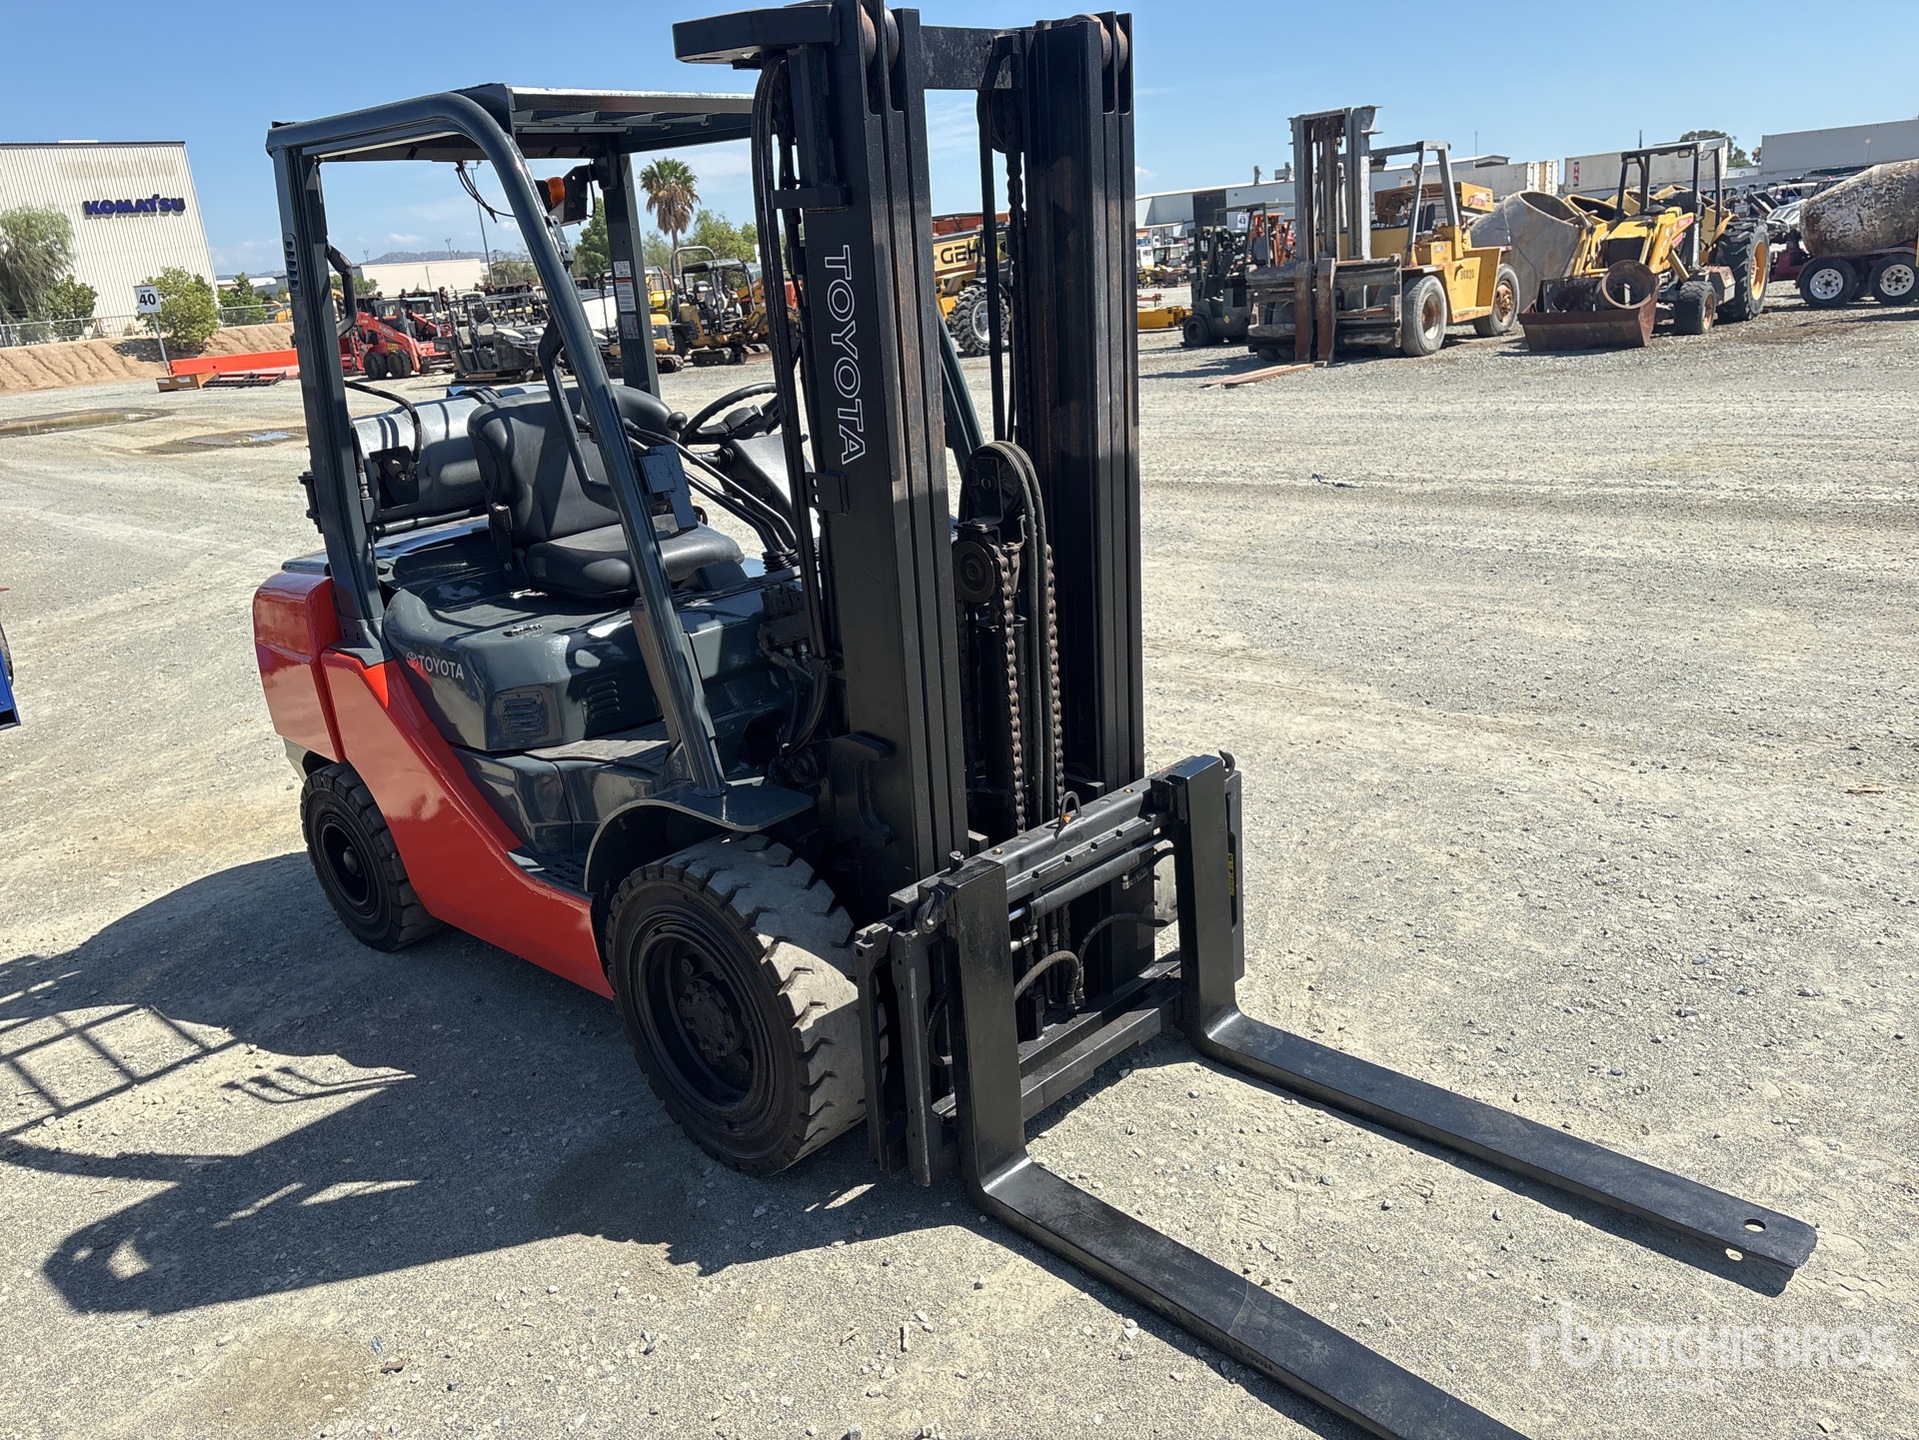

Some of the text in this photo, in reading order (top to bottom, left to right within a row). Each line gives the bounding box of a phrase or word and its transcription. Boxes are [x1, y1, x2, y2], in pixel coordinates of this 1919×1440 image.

[83, 194, 186, 215] KOMATSU
[139, 293, 156, 306] 40
[824, 244, 867, 466] TOYOTA
[418, 654, 465, 681] TOYOTA
